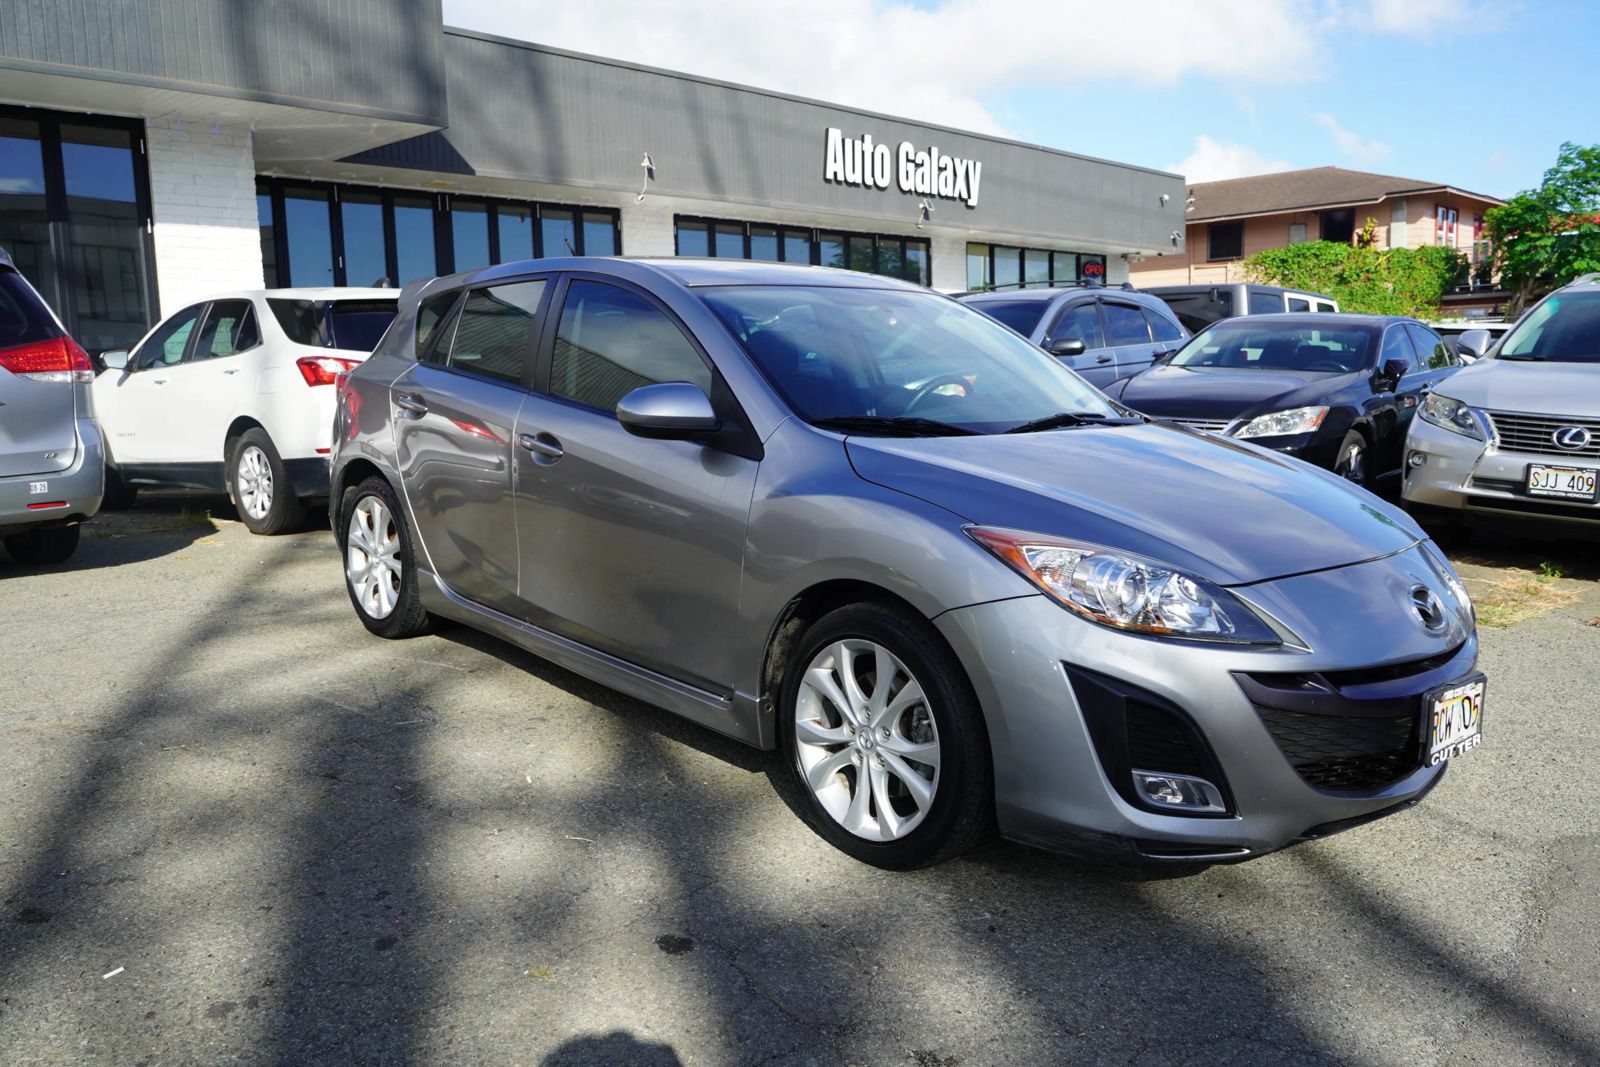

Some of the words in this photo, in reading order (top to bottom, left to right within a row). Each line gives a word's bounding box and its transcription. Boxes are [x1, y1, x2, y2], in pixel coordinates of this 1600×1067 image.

[825, 127, 891, 189] Auto
[898, 141, 982, 207] Galaxy
[1085, 263, 1104, 276] OPEN
[1531, 471, 1558, 488] SJJ
[1567, 475, 1594, 492] 409
[1433, 704, 1454, 746] RCW
[1431, 733, 1481, 766] CUTTER
